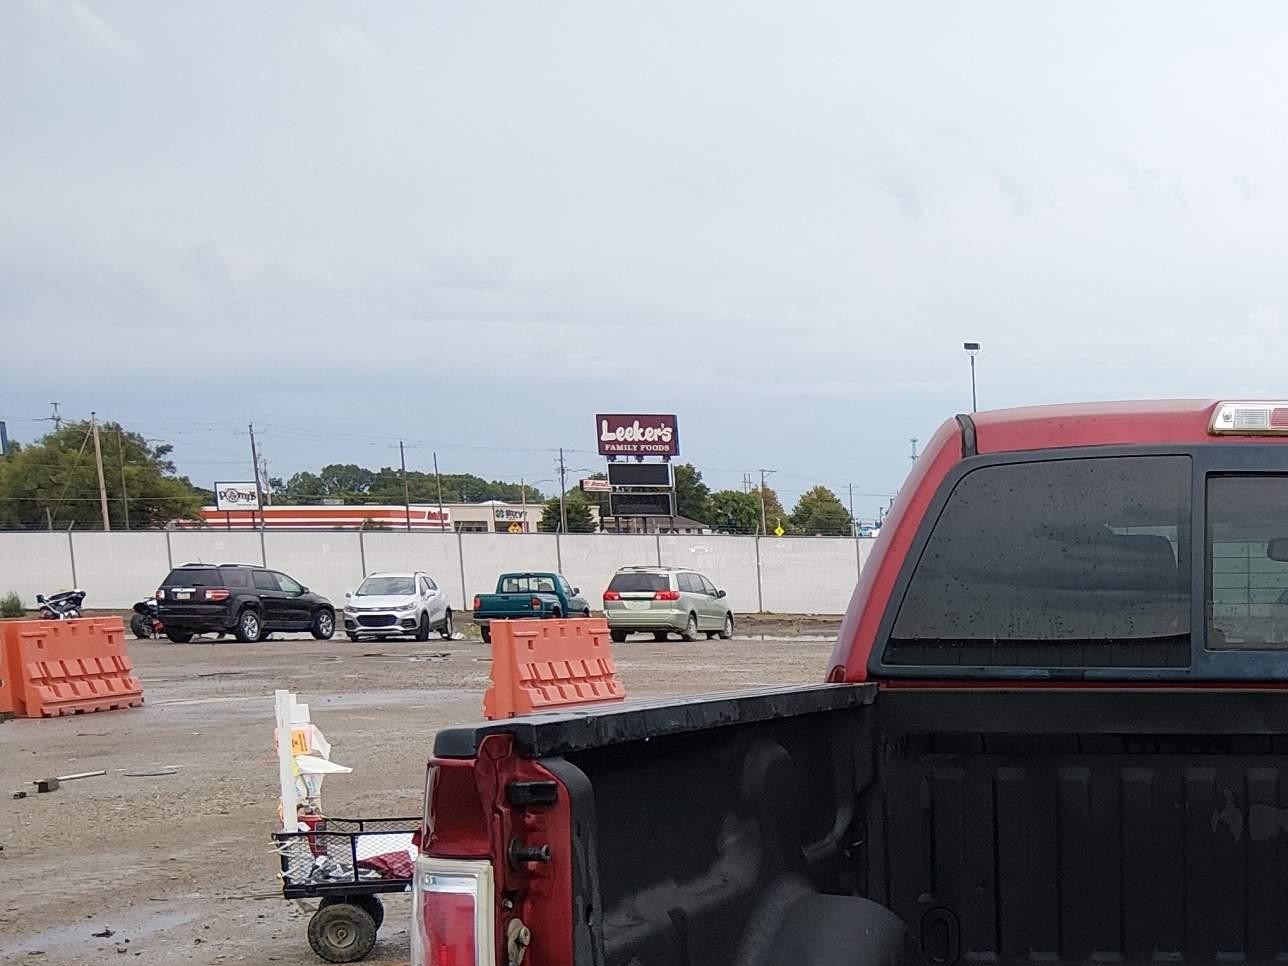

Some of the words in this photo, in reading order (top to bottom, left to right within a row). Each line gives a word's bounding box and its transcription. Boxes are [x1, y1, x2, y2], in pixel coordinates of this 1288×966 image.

[600, 419, 673, 443] Leeker's
[604, 444, 638, 452] FAMILY
[640, 444, 670, 452] FOODS
